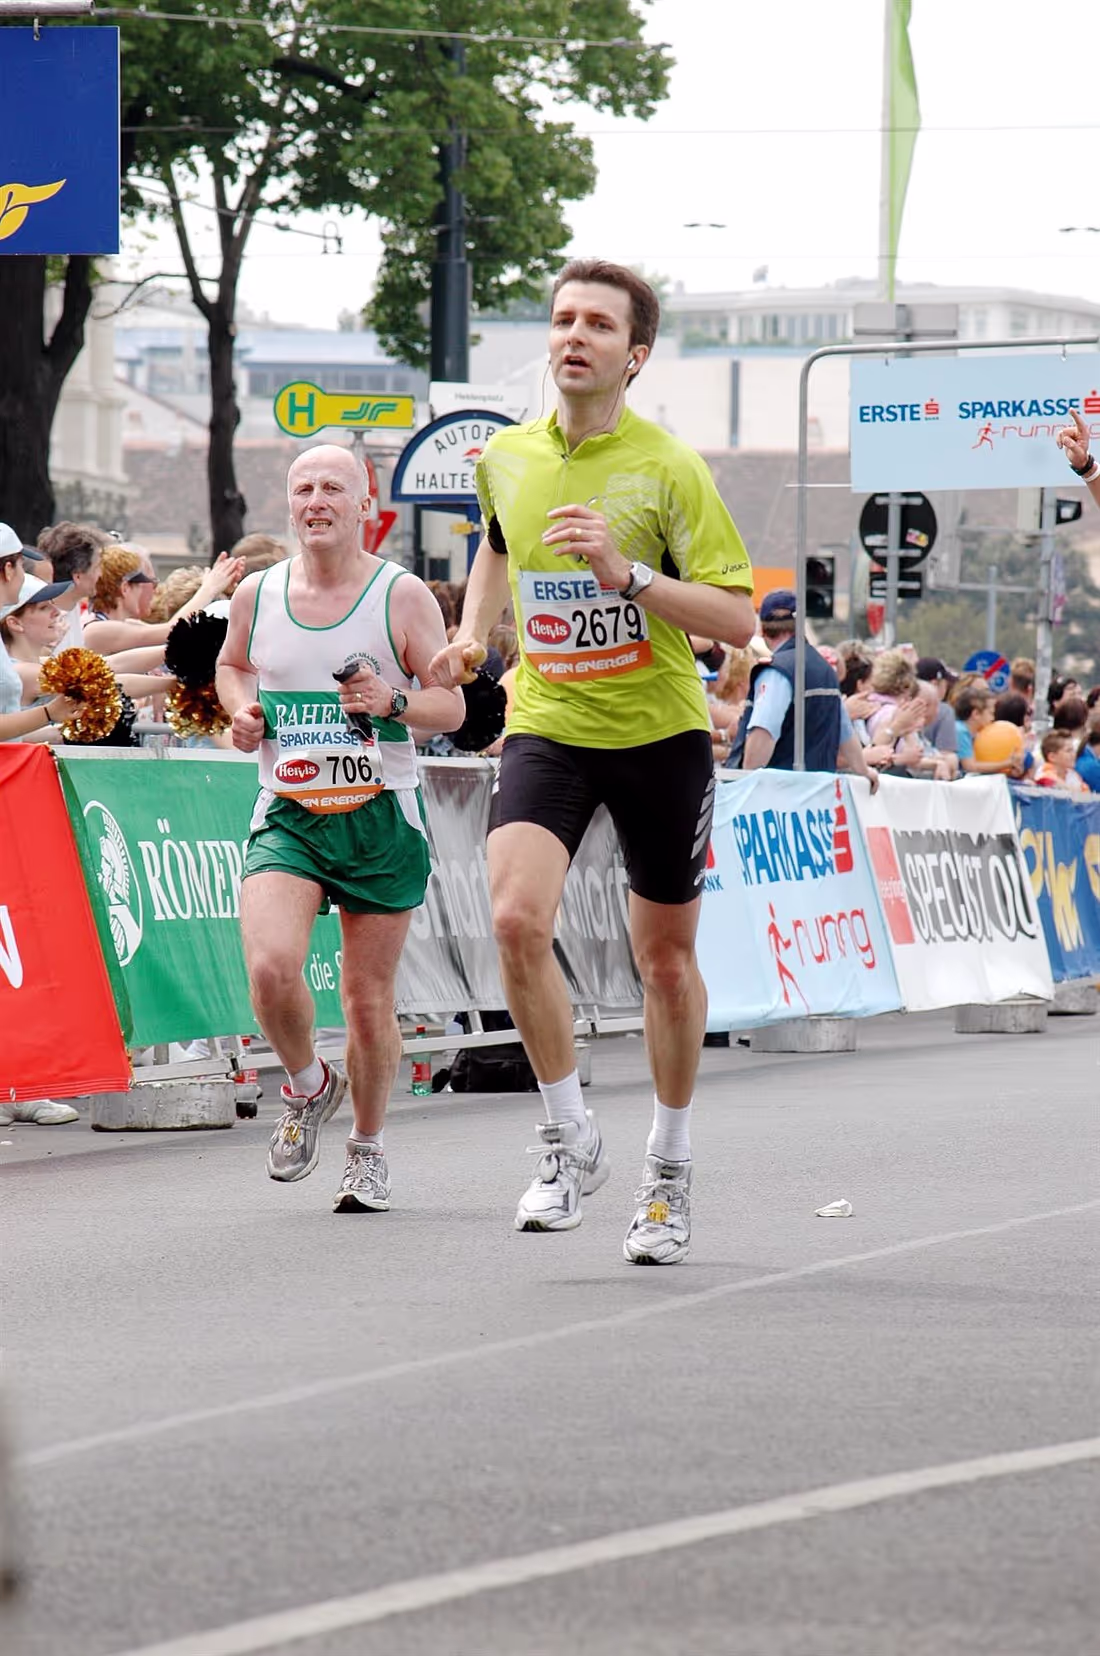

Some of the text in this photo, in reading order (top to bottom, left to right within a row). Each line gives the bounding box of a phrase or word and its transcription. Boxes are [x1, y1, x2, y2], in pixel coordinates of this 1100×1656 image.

[288, 393, 315, 426] H
[859, 404, 921, 423] ERSTE
[958, 398, 1080, 420] SPARKASSE
[534, 579, 597, 601] ERSTE
[531, 618, 568, 638] Hervis
[572, 603, 642, 648] 2679
[538, 650, 639, 674] WIEN ENERGIE
[280, 731, 358, 748] SPARKASSE
[279, 765, 316, 778] Hervis
[326, 755, 373, 785] 706
[310, 953, 336, 991] die
